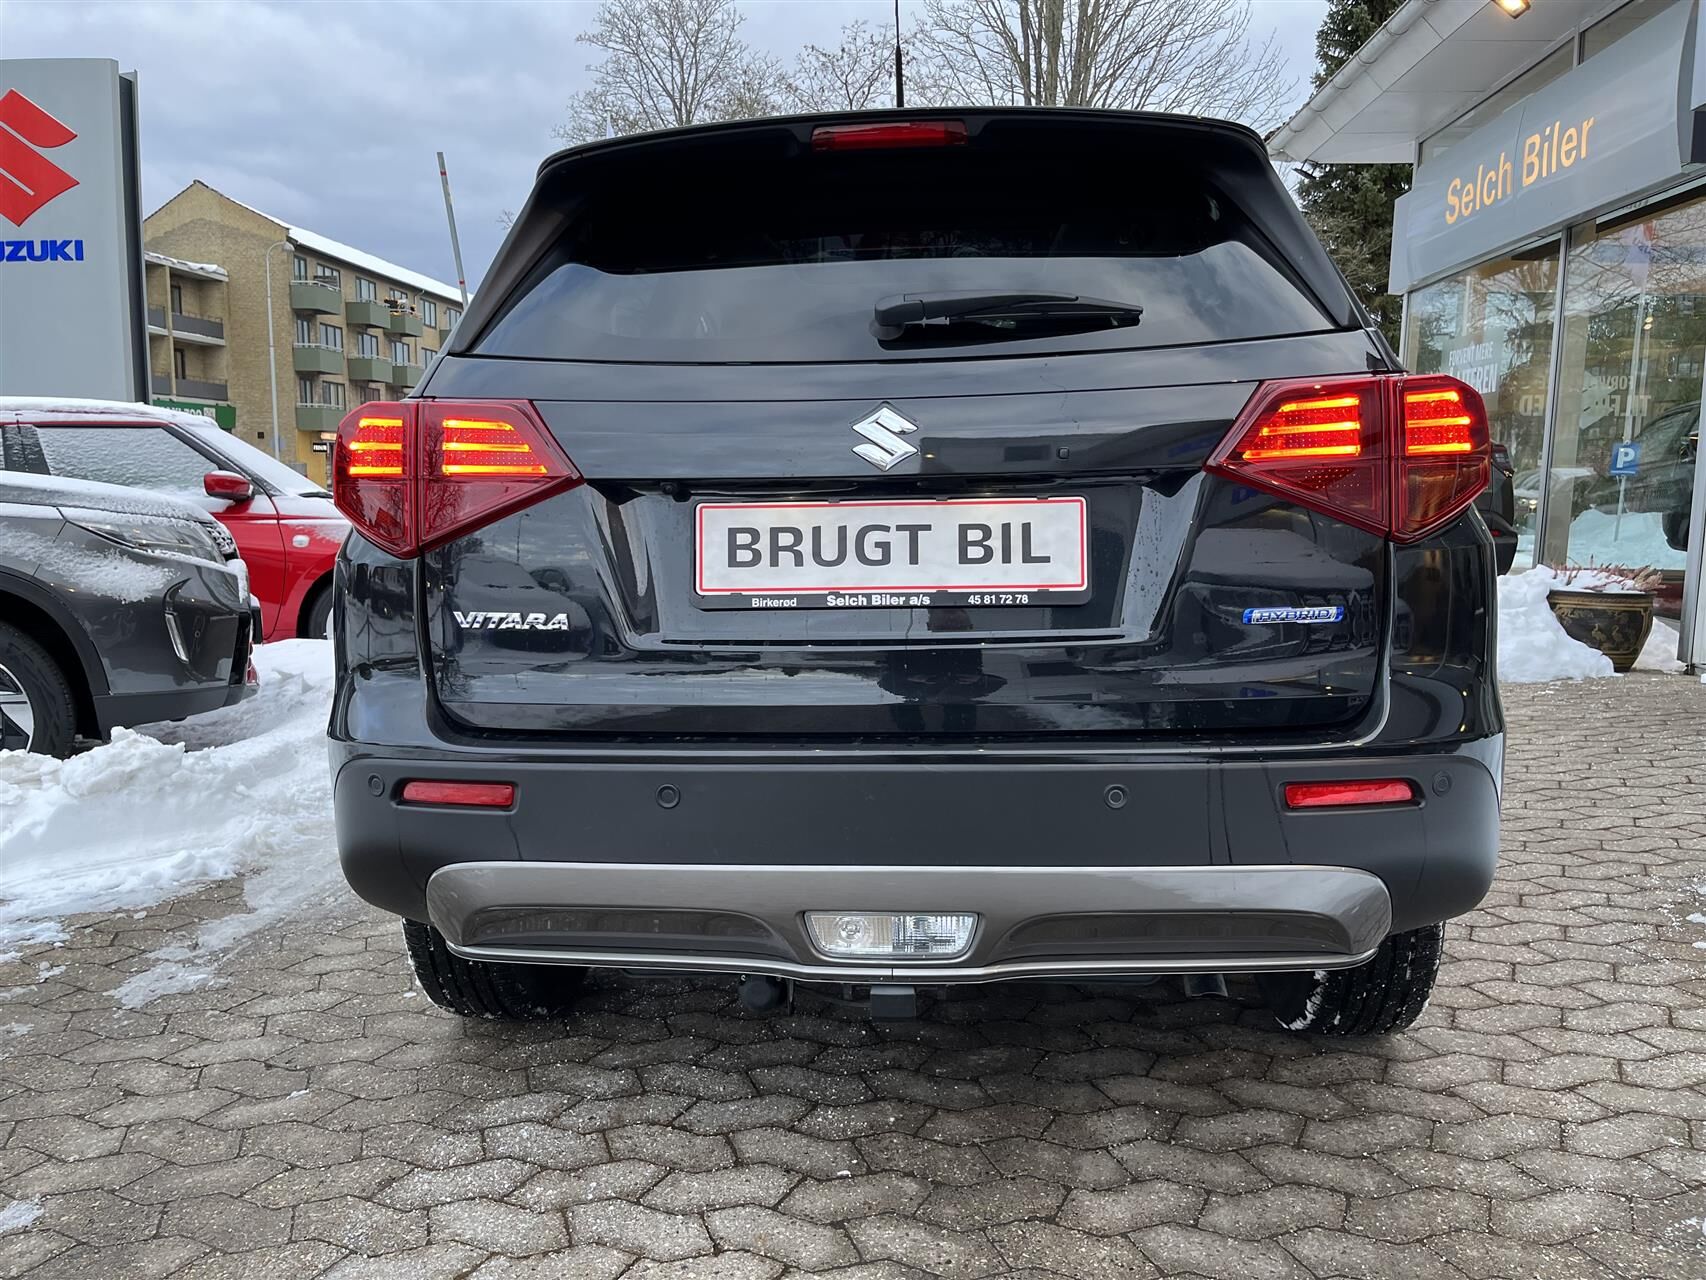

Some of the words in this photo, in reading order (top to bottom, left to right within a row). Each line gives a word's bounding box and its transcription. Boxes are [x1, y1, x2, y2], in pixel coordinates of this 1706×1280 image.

[1445, 152, 1513, 225] Selch
[1522, 116, 1595, 188] Biler
[0, 239, 84, 262] ZUKI
[1615, 447, 1636, 469] P
[727, 523, 932, 568] BRUGT
[958, 521, 1051, 565] BIL
[751, 597, 797, 608] Birkerød
[826, 594, 867, 607] Selch
[871, 594, 906, 606] Biler
[909, 594, 931, 605] a/s
[967, 595, 981, 605] 45
[983, 595, 996, 605] 81
[999, 595, 1013, 605] 72
[1015, 595, 1029, 604] 78
[452, 611, 570, 631] VITARA
[1258, 608, 1332, 622] HYBRID
